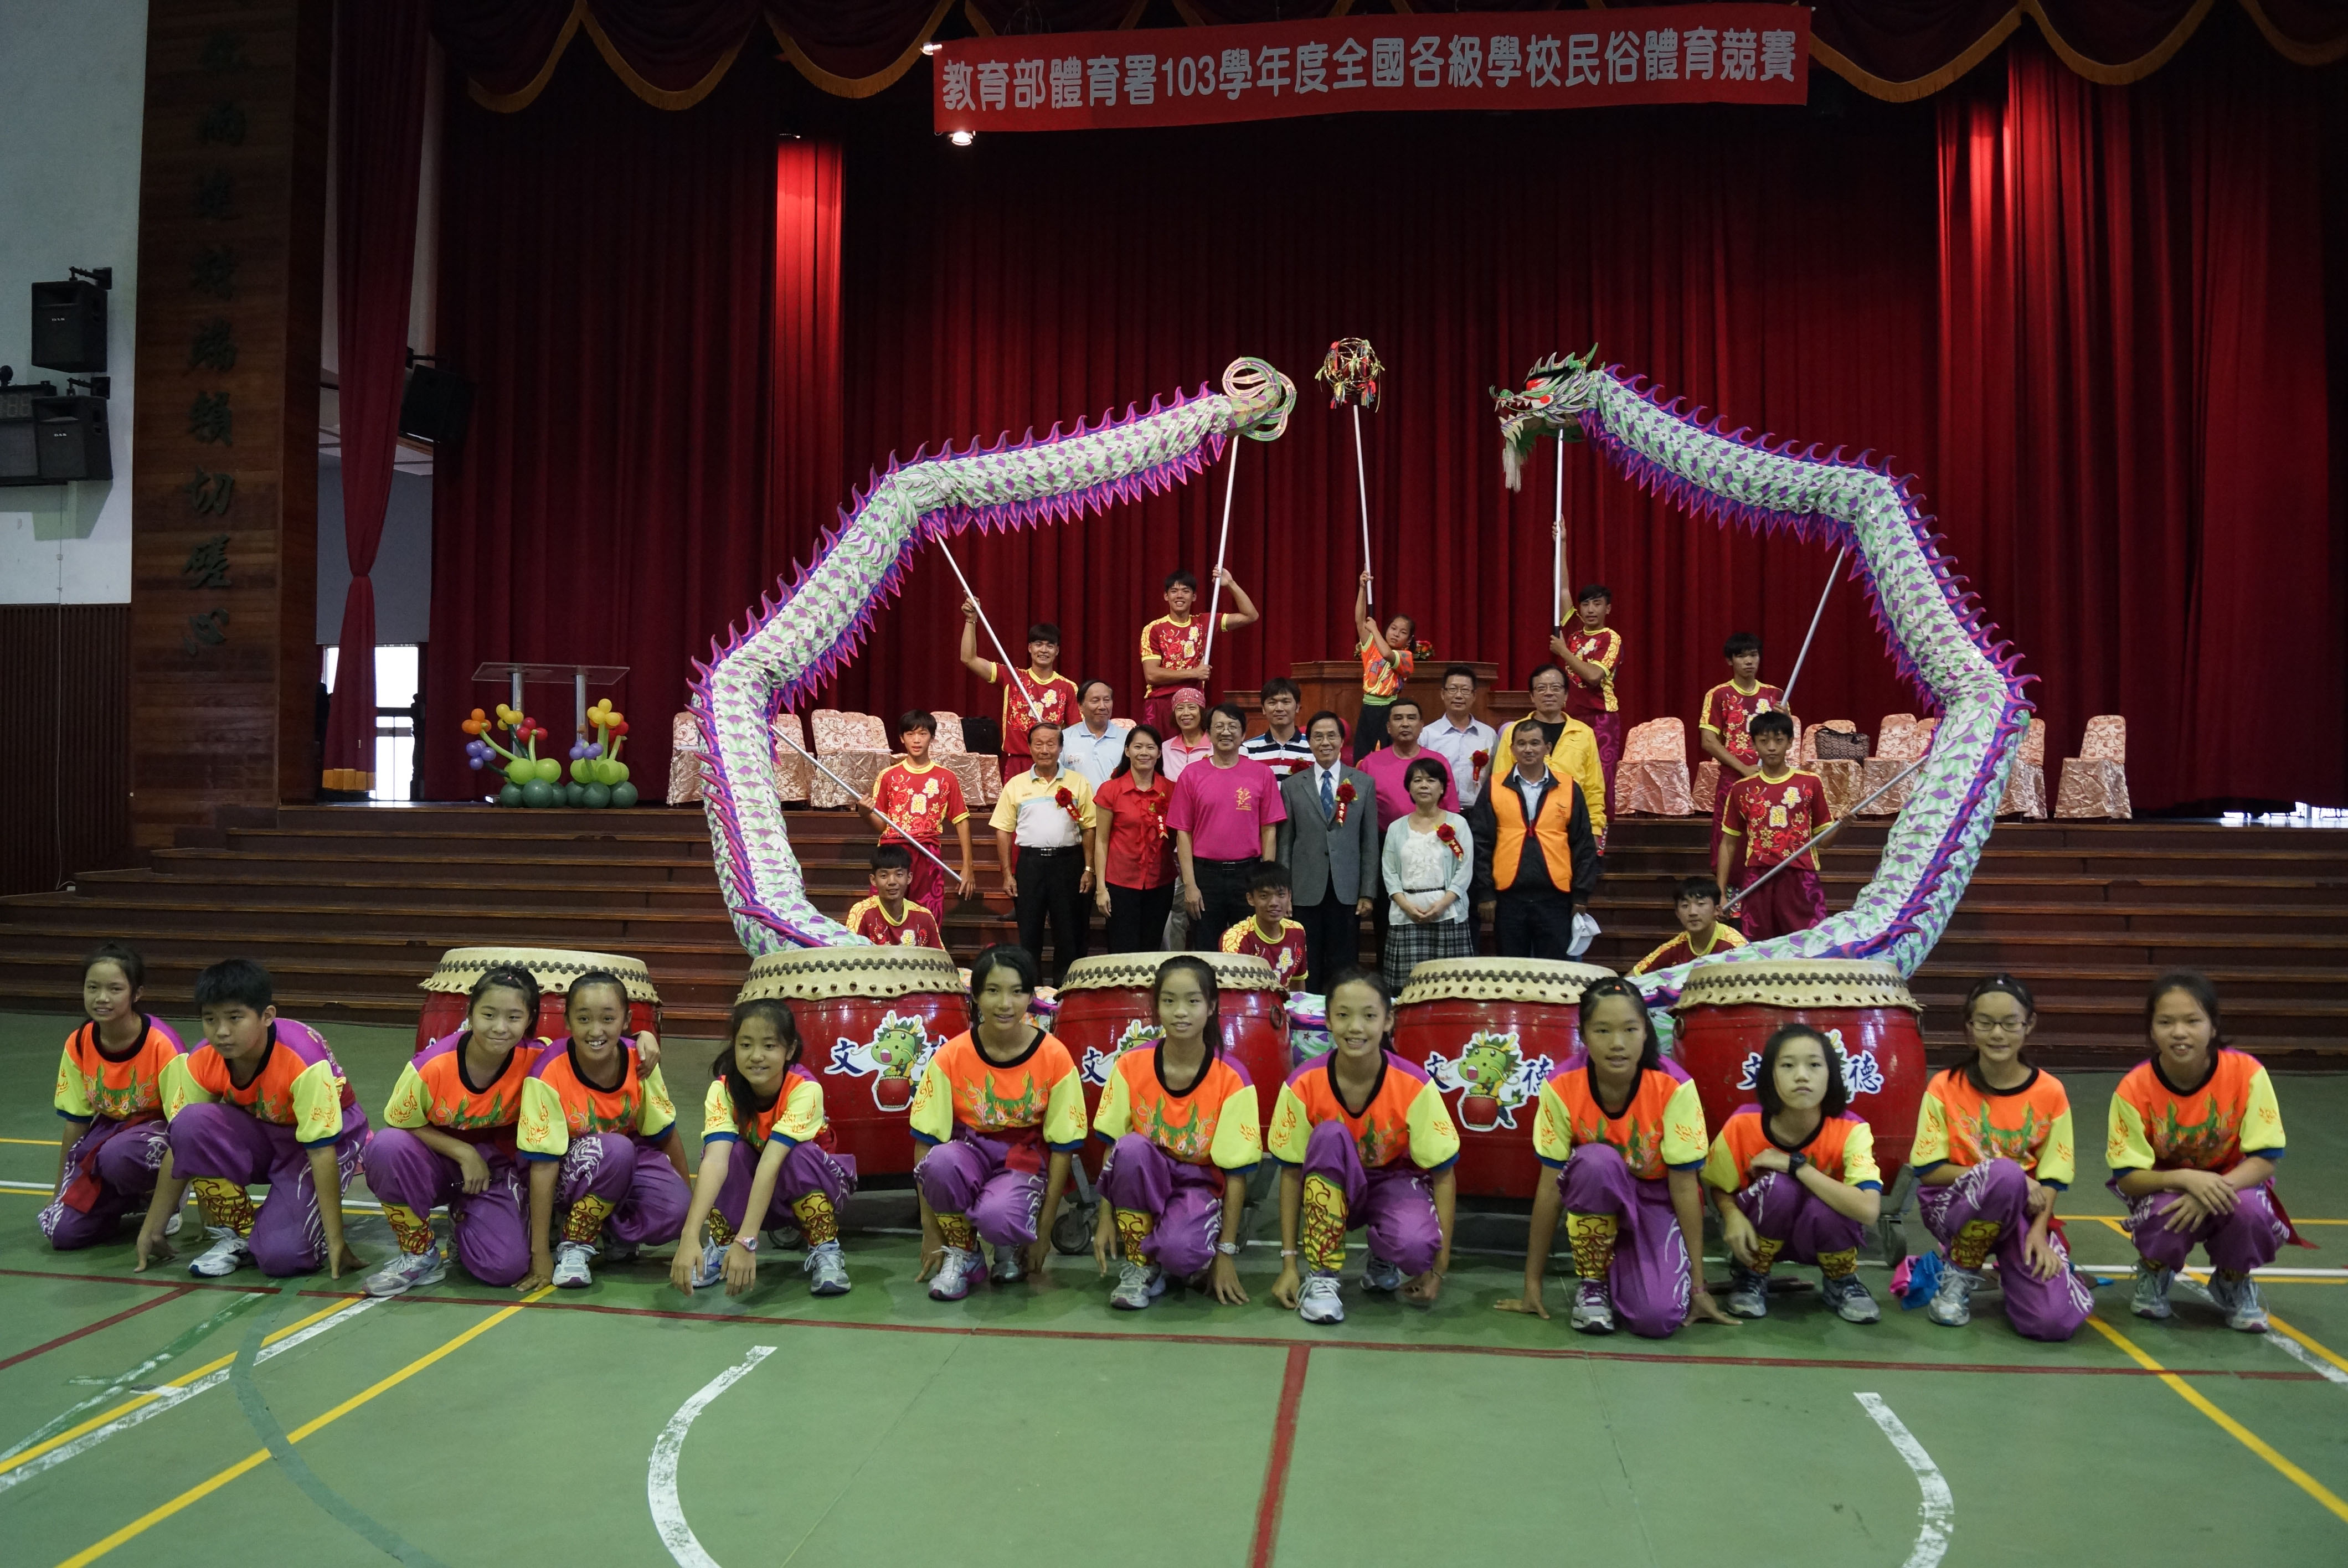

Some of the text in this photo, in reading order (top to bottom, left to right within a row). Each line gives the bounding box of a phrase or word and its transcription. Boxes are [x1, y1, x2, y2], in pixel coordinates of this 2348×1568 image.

[943, 26, 1796, 111] 教育部體育署103學年度全國各級學校民俗體育競賽
